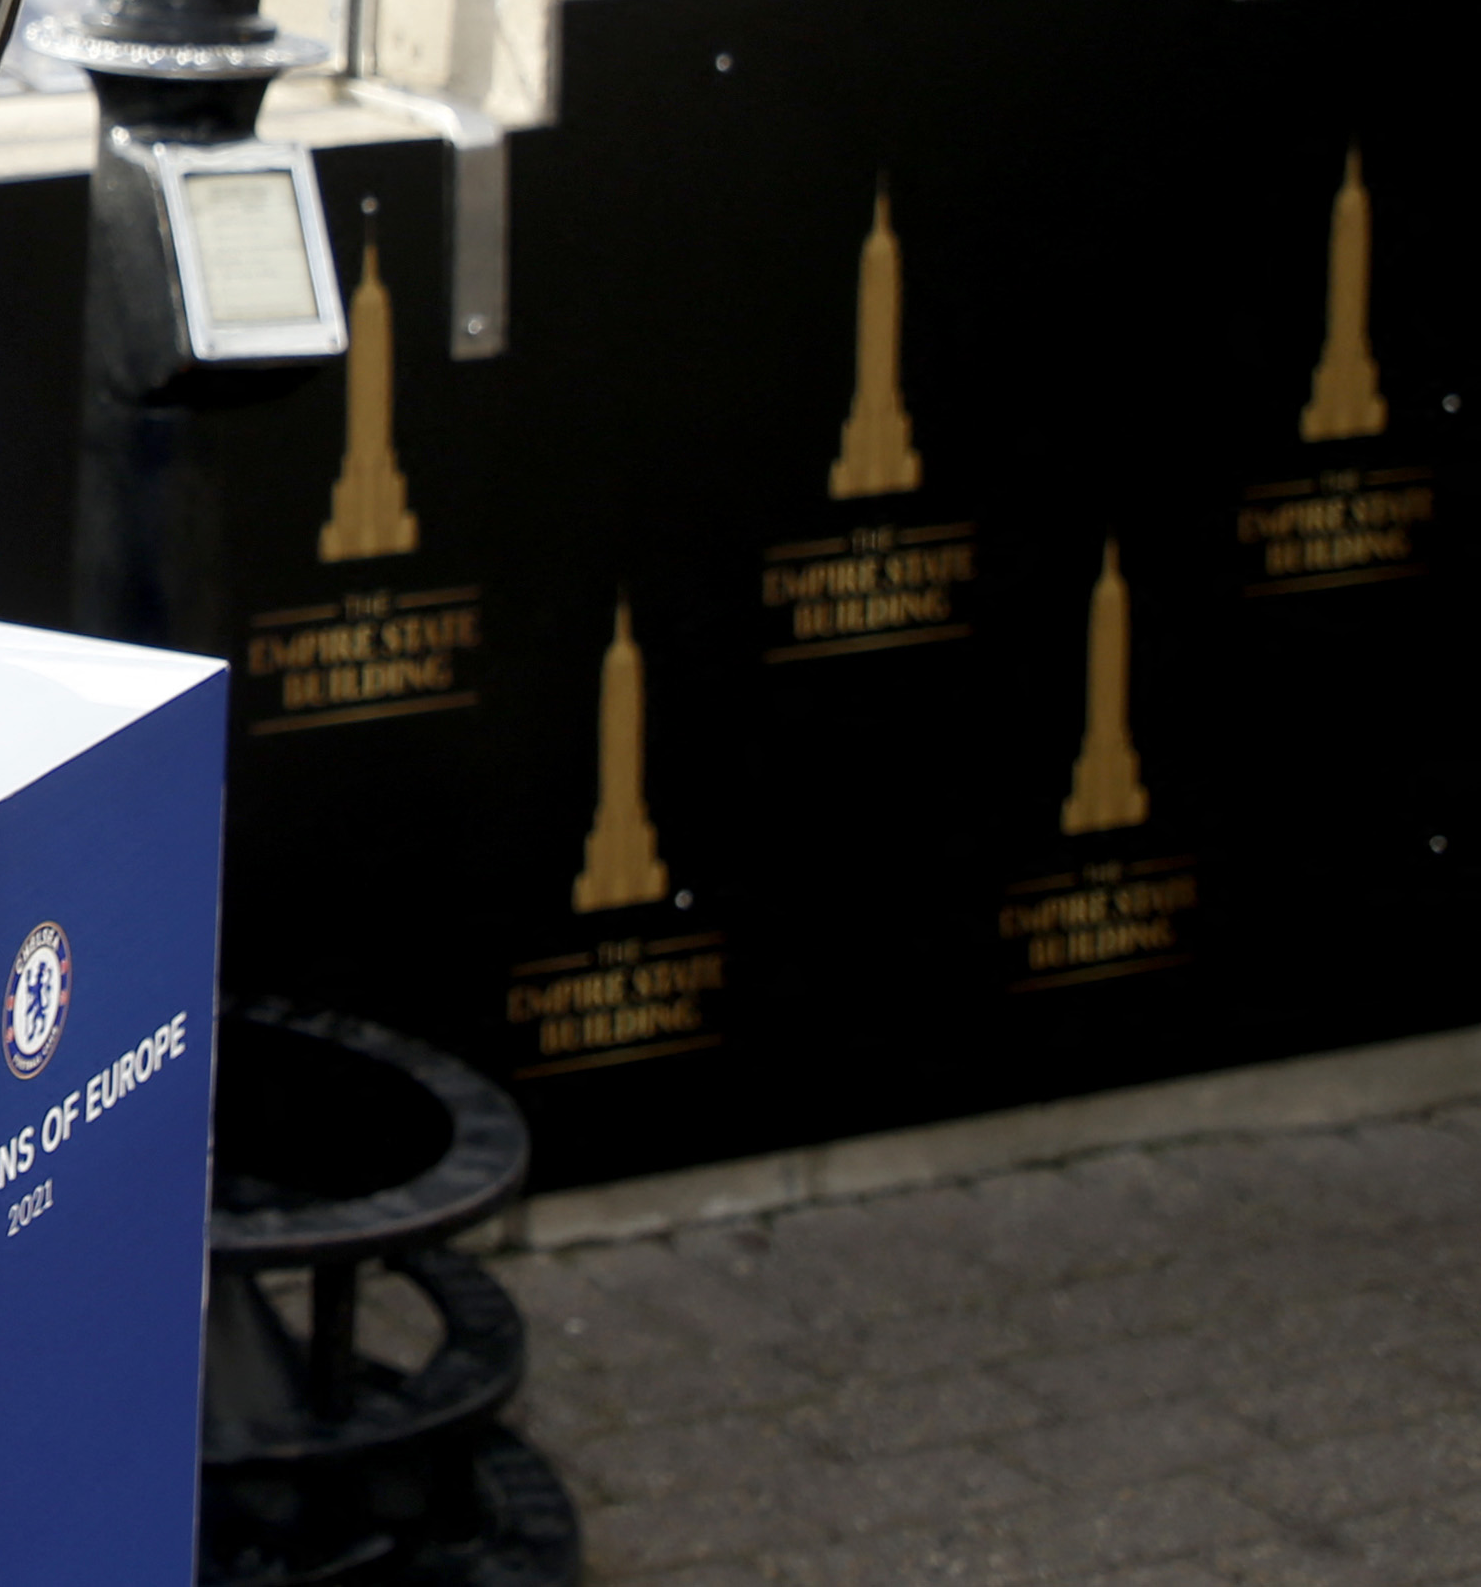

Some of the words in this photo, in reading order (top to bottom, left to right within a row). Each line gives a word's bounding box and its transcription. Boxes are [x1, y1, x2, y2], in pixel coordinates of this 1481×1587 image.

[248, 621, 379, 676] EMPIRE
[380, 606, 483, 656] STATE
[282, 653, 454, 710] BUILDING
[41, 1091, 80, 1153] OF
[85, 1011, 187, 1123] EUROPE
[7, 1179, 54, 1237] 2021
